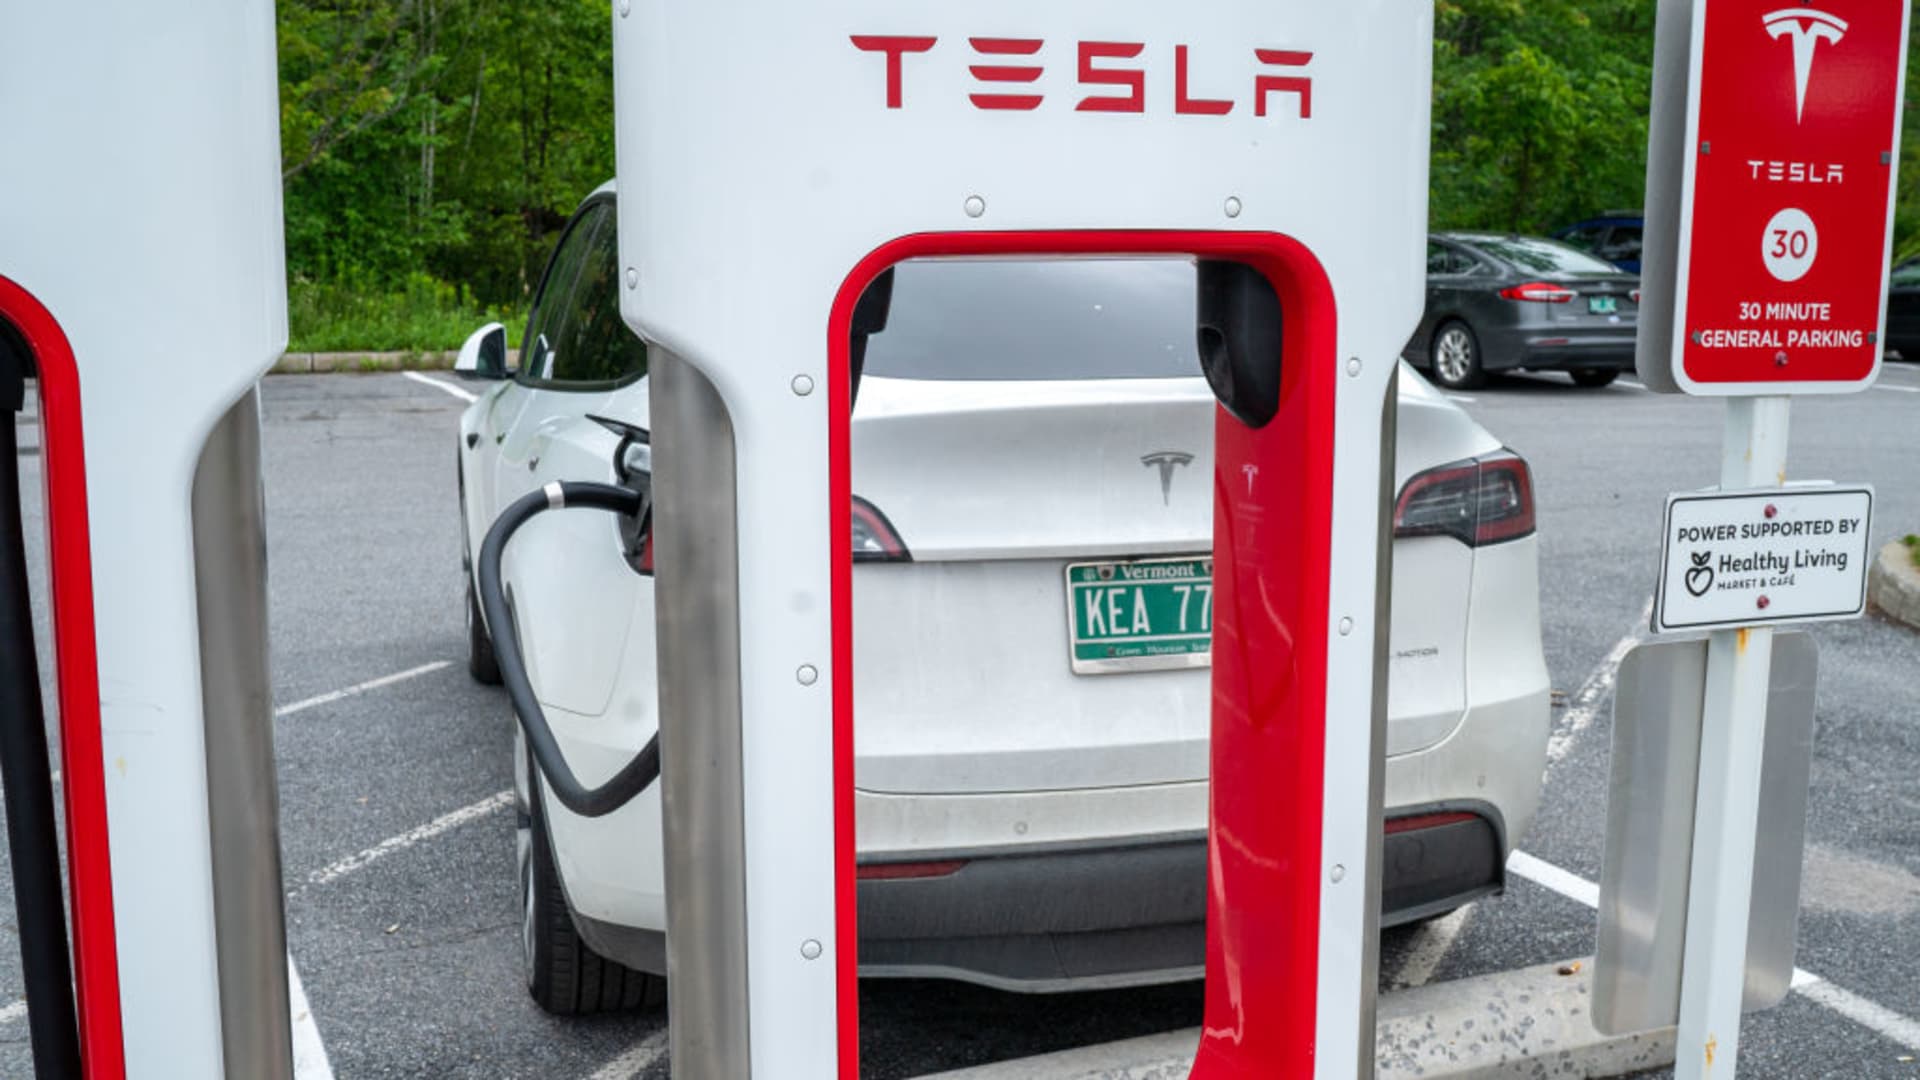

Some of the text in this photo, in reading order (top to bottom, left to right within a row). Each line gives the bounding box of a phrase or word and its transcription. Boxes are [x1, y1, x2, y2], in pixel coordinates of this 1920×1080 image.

[849, 35, 1314, 118] TESLA
[1747, 160, 1844, 183] TESLA
[1771, 229, 1809, 259] 30
[1739, 302, 1831, 321] 30 MINUTE
[1700, 329, 1863, 348] GENERAL PARKING
[1677, 518, 1860, 542] POWER SUPPORTED BY
[1121, 564, 1195, 578] Vermont
[1718, 548, 1848, 574] Healthy Living
[1717, 578, 1757, 590] MARKET
[1085, 587, 1151, 636] KEA
